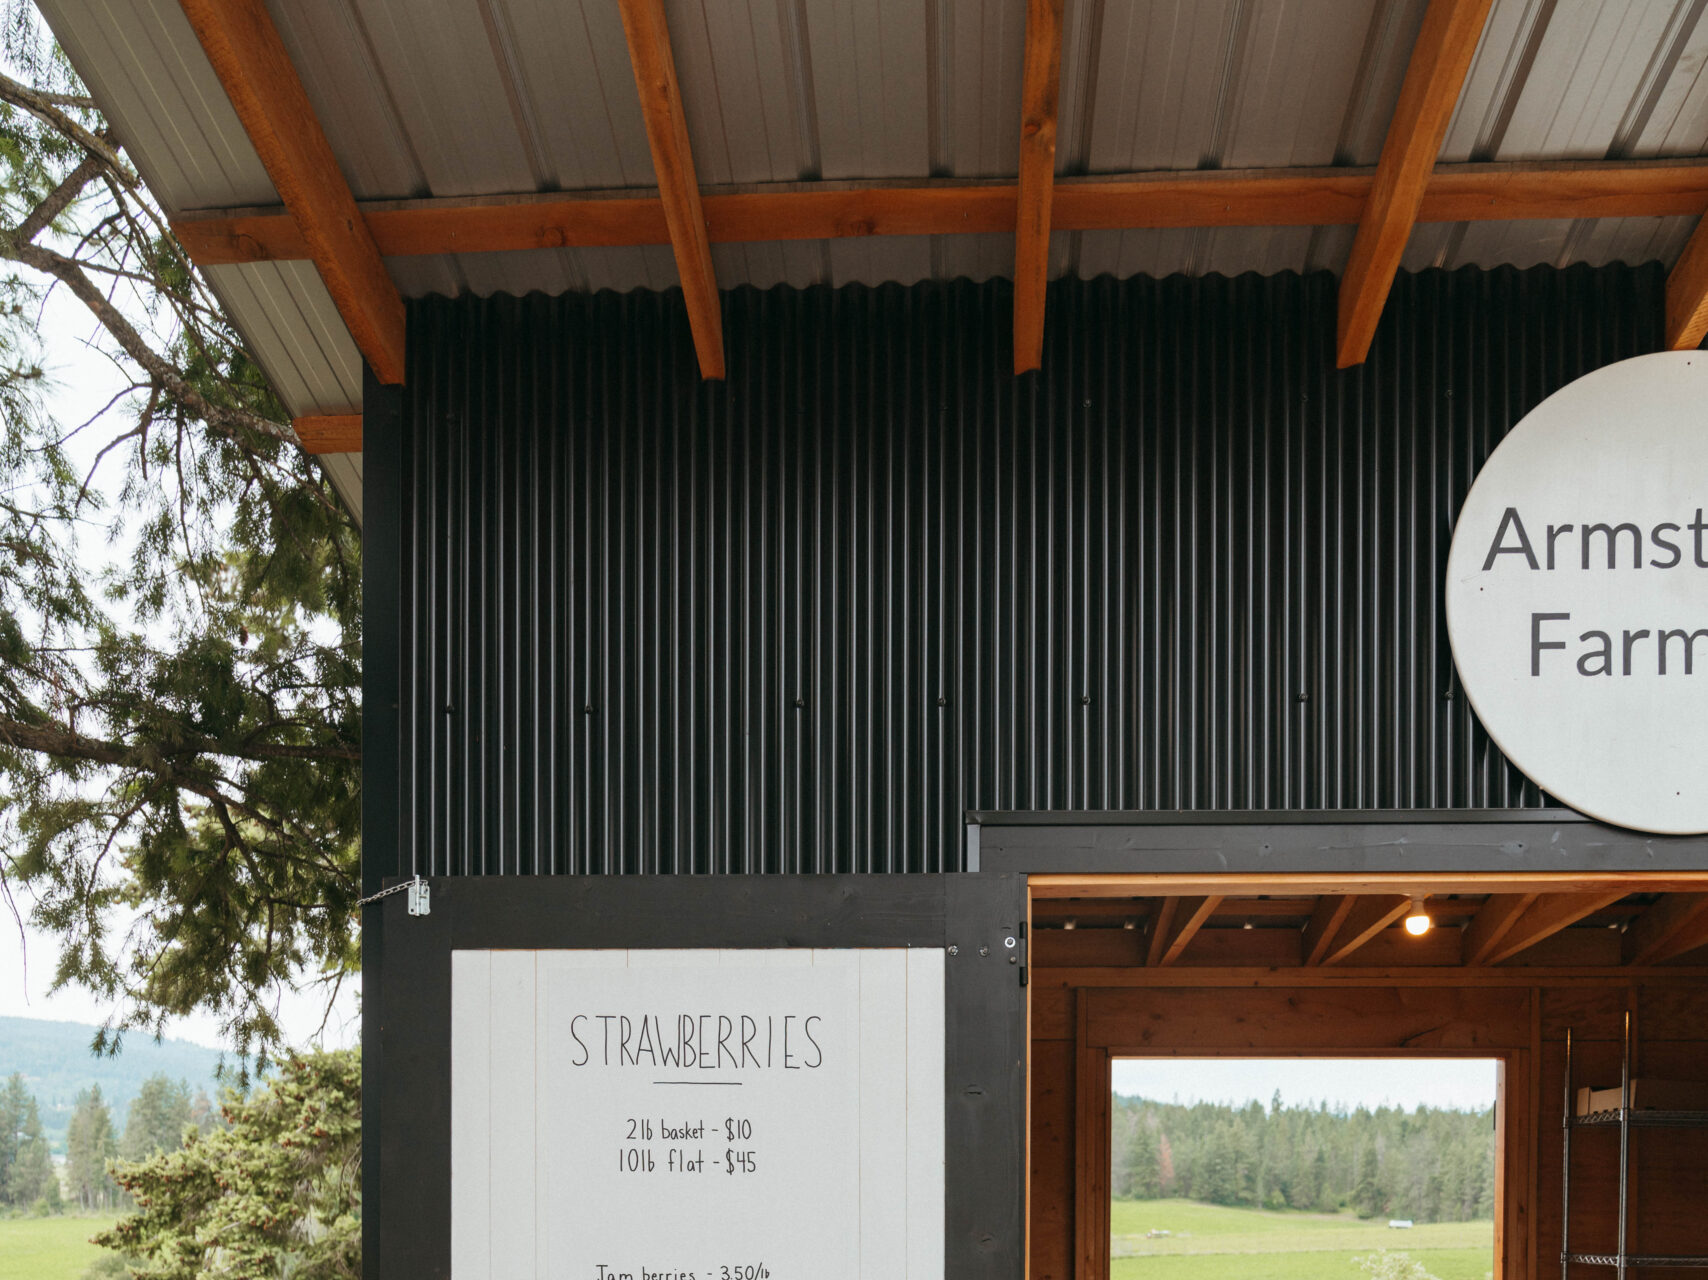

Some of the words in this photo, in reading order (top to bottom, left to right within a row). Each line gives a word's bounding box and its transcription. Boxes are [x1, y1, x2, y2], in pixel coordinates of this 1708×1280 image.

[1481, 507, 1708, 571] Armst
[1530, 612, 1708, 677] Farm
[570, 1014, 823, 1069] STRAWBERRIES
[661, 1118, 705, 1140] basket
[724, 1117, 752, 1142] $10
[619, 1148, 655, 1172] 10lb
[667, 1148, 705, 1173] flat
